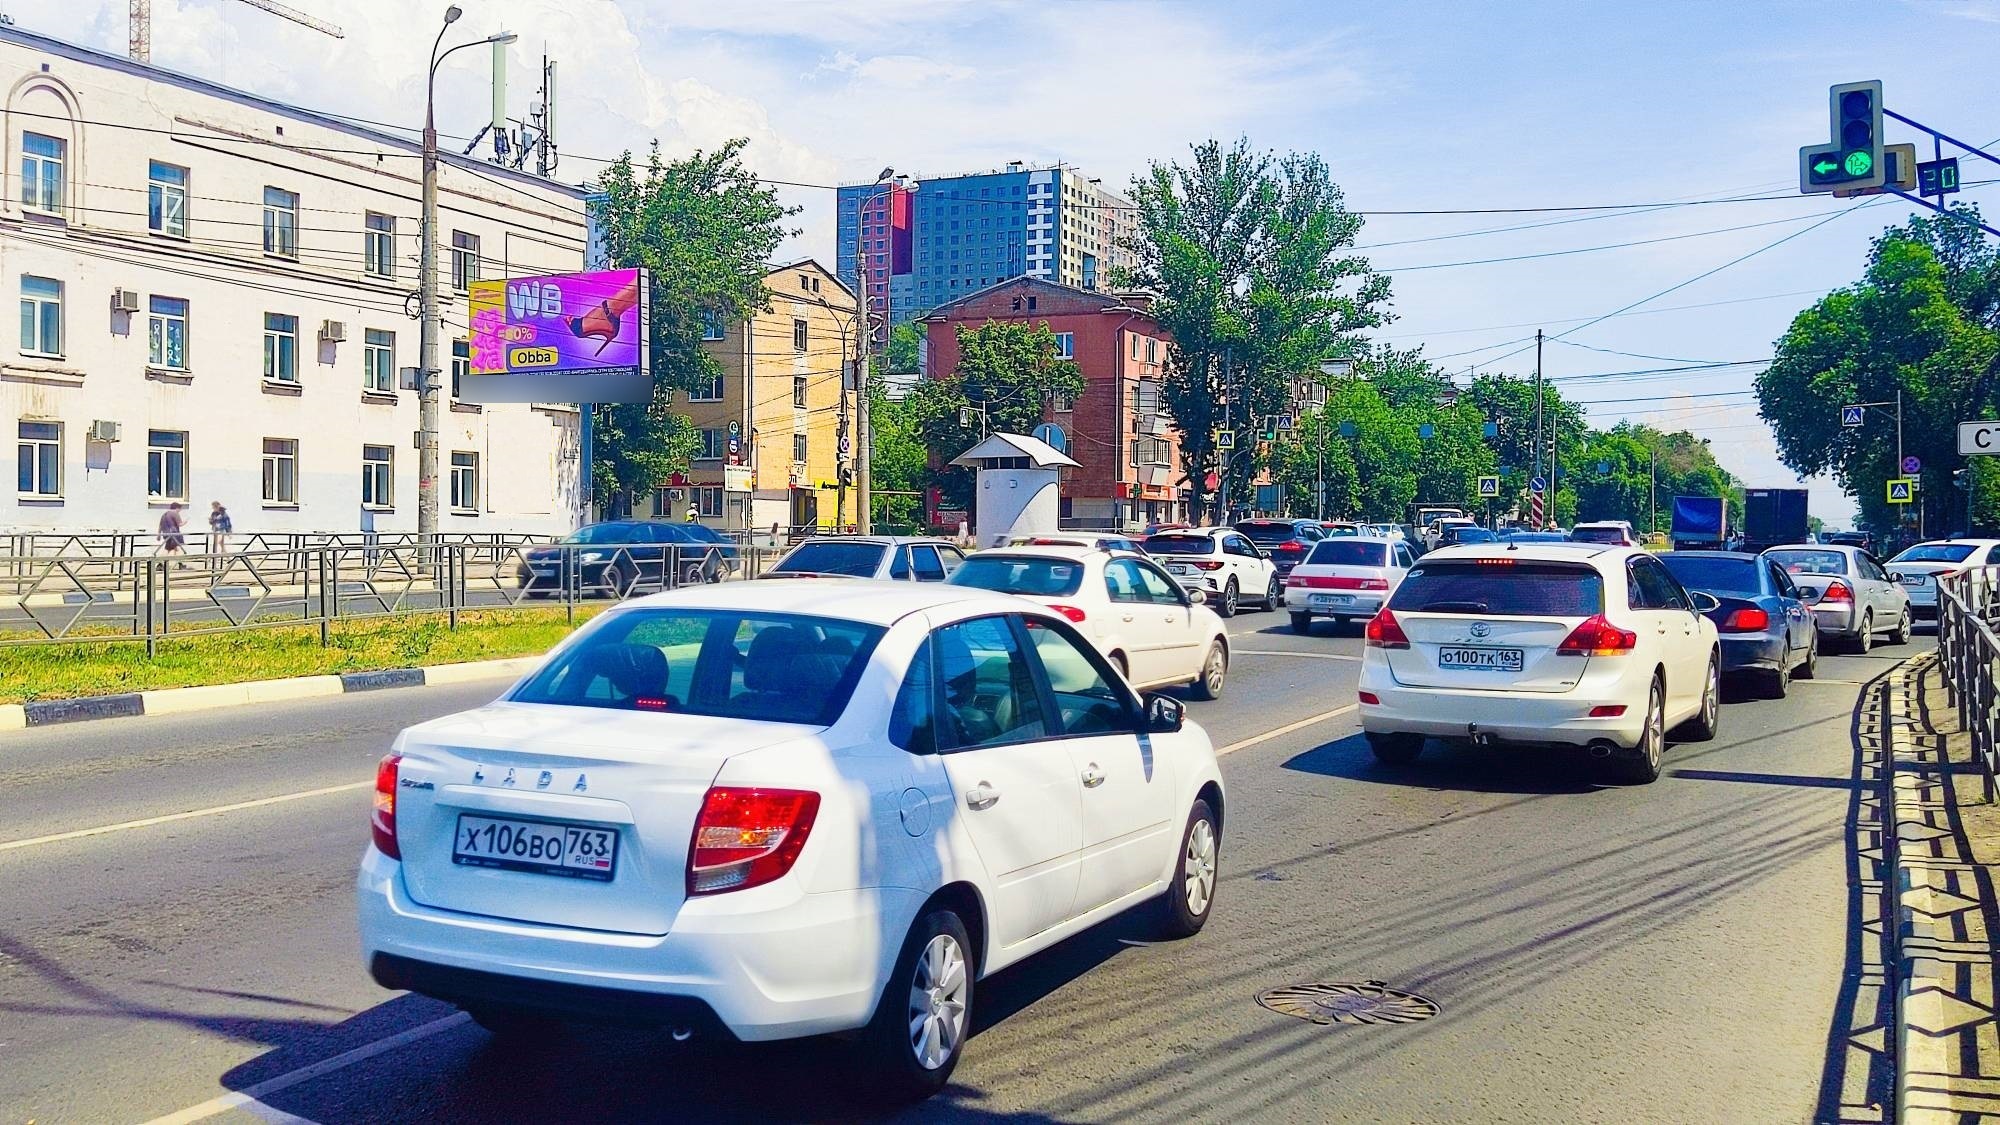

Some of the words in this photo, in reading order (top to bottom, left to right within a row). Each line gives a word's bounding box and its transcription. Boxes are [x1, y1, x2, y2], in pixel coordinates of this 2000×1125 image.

[508, 280, 562, 320] WB
[517, 350, 551, 364] Obba
[1974, 427, 2000, 449] С
[1444, 650, 1495, 665] О100ТК
[1498, 651, 1517, 662] 163
[474, 764, 588, 792] LADA
[464, 823, 562, 860] Х106ВО
[568, 830, 608, 856] 763
[575, 854, 595, 866] RUS
